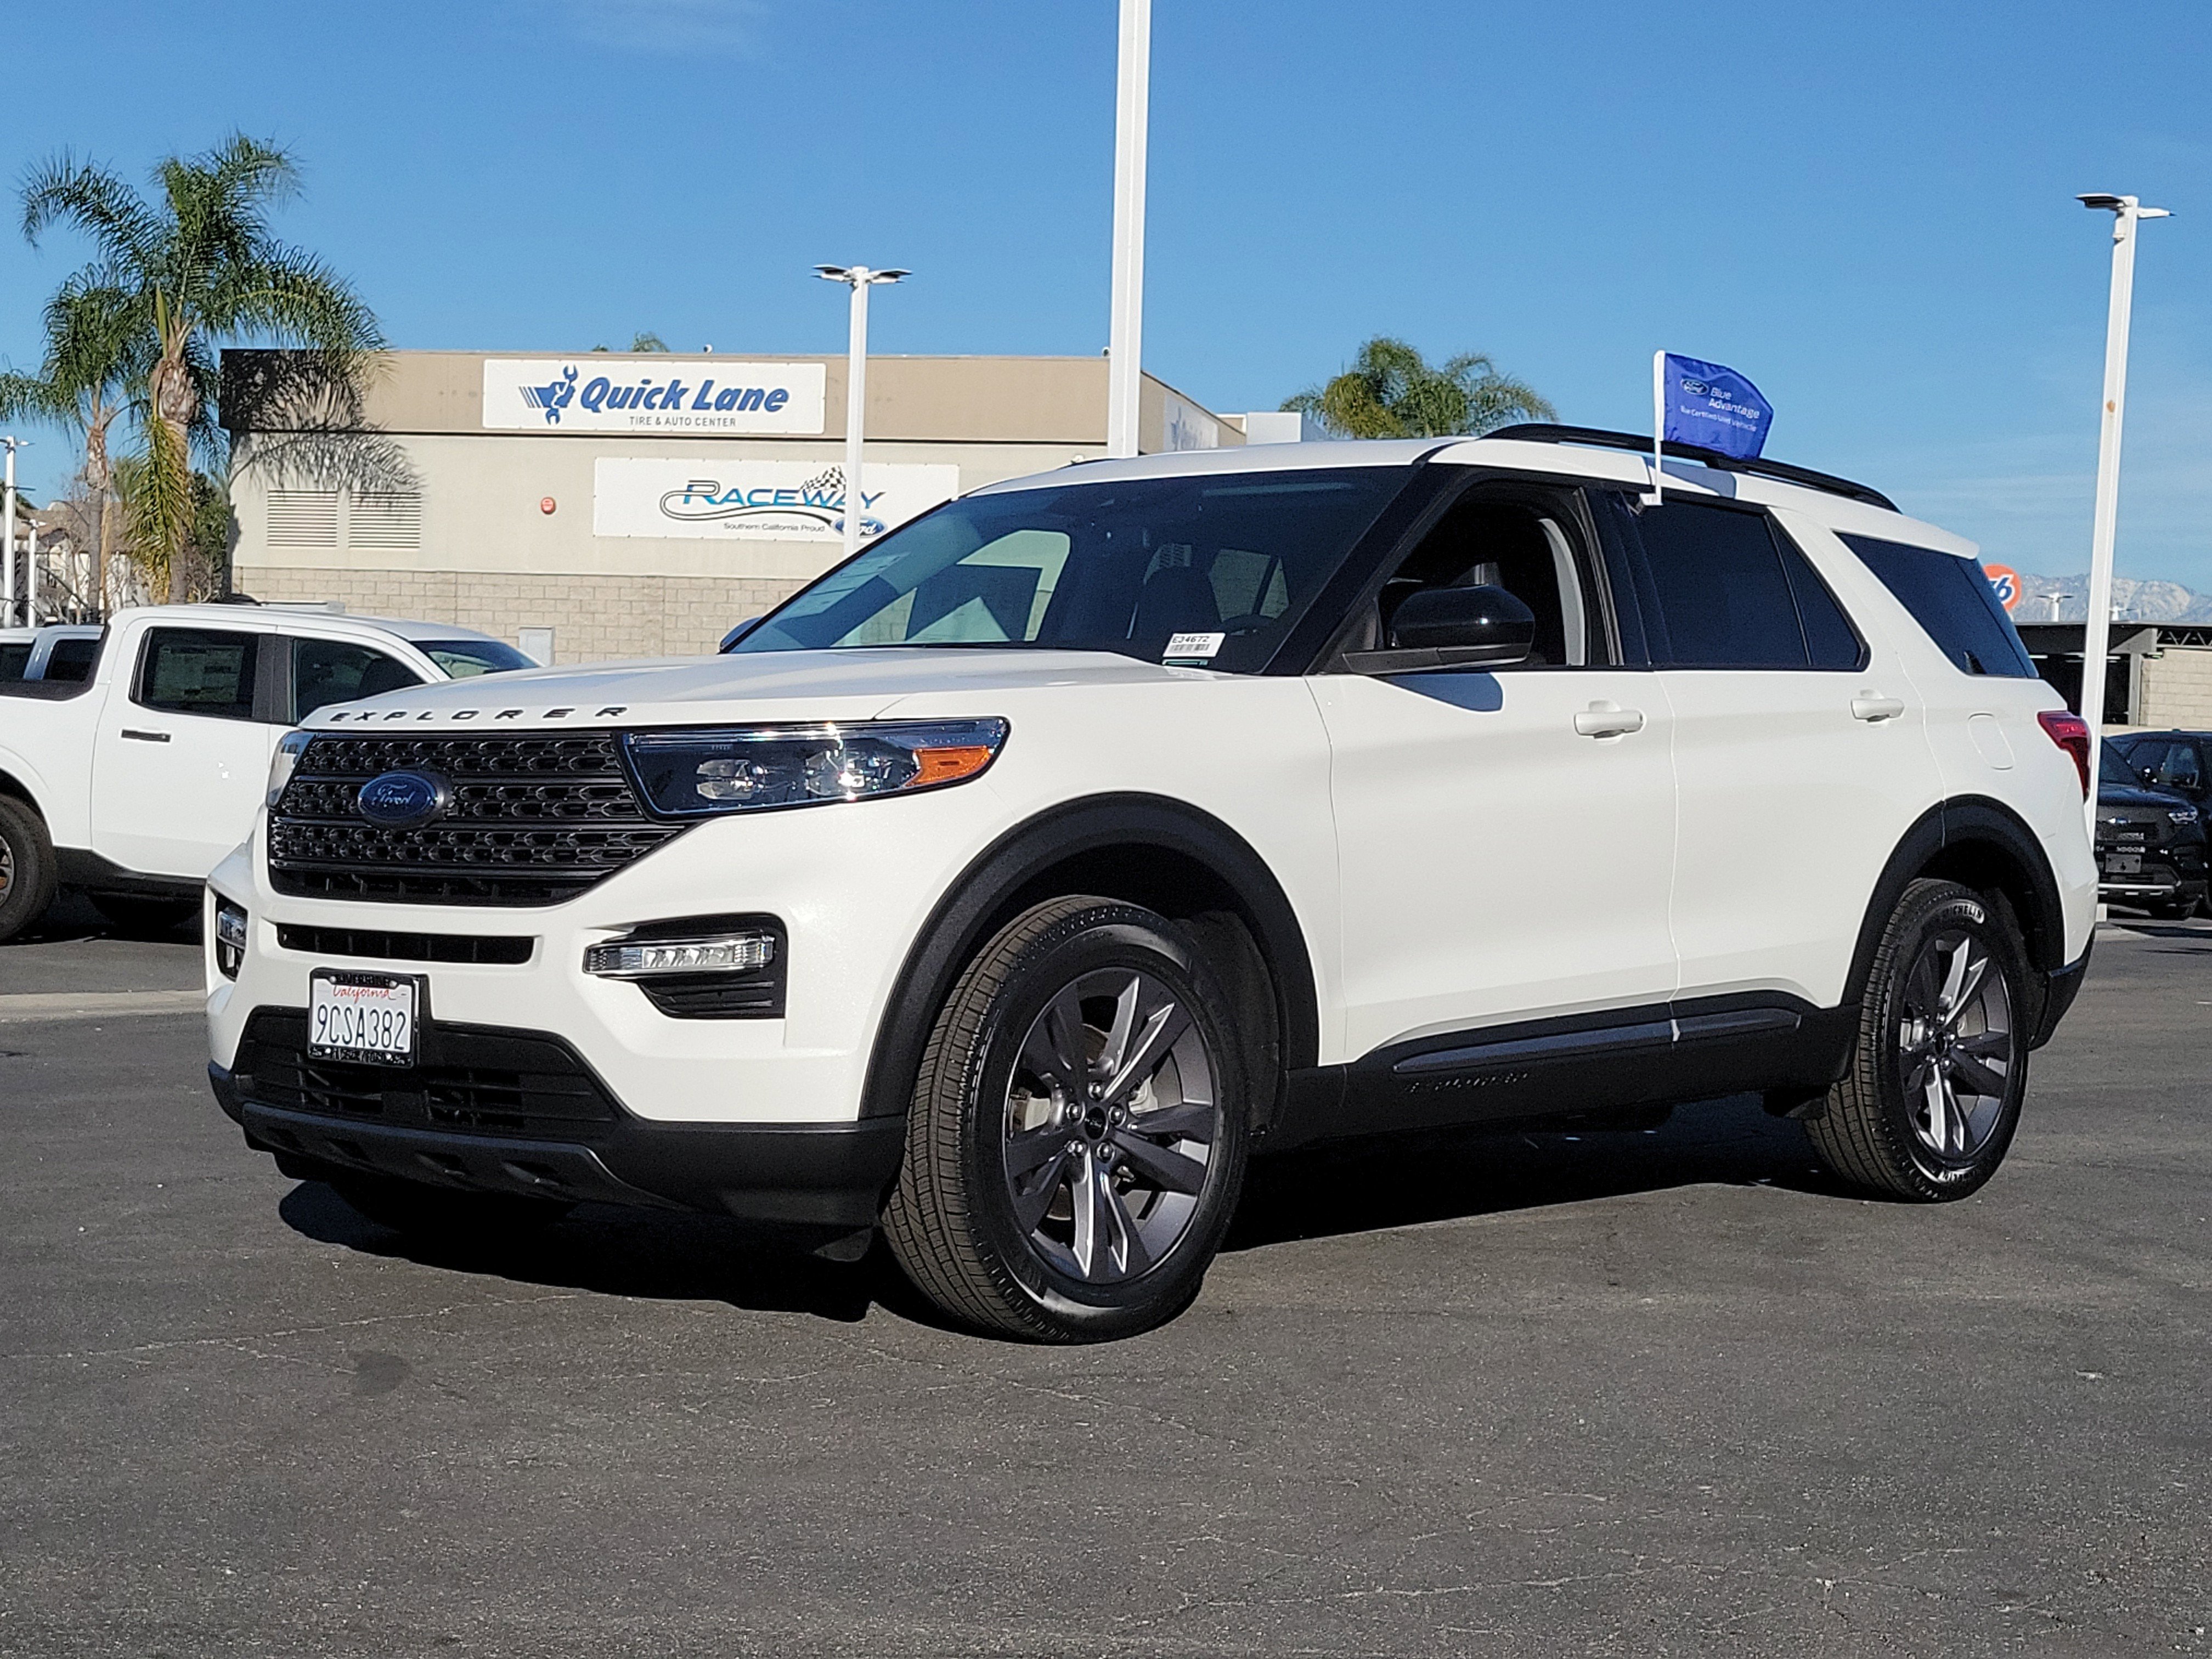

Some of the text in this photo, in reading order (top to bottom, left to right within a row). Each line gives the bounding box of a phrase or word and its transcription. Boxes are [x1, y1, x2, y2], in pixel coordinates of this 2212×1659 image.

[580, 376, 789, 413] Quick Lane
[1711, 387, 1731, 400] Blue
[1708, 398, 1760, 419] Advantage
[629, 416, 736, 427] TIRE & AUTO CENTER
[1987, 575, 2013, 602] 6
[329, 706, 628, 723] EXPLORER
[371, 783, 416, 807] Ford
[333, 985, 394, 1005] California
[315, 1003, 407, 1051] 9CSA382
